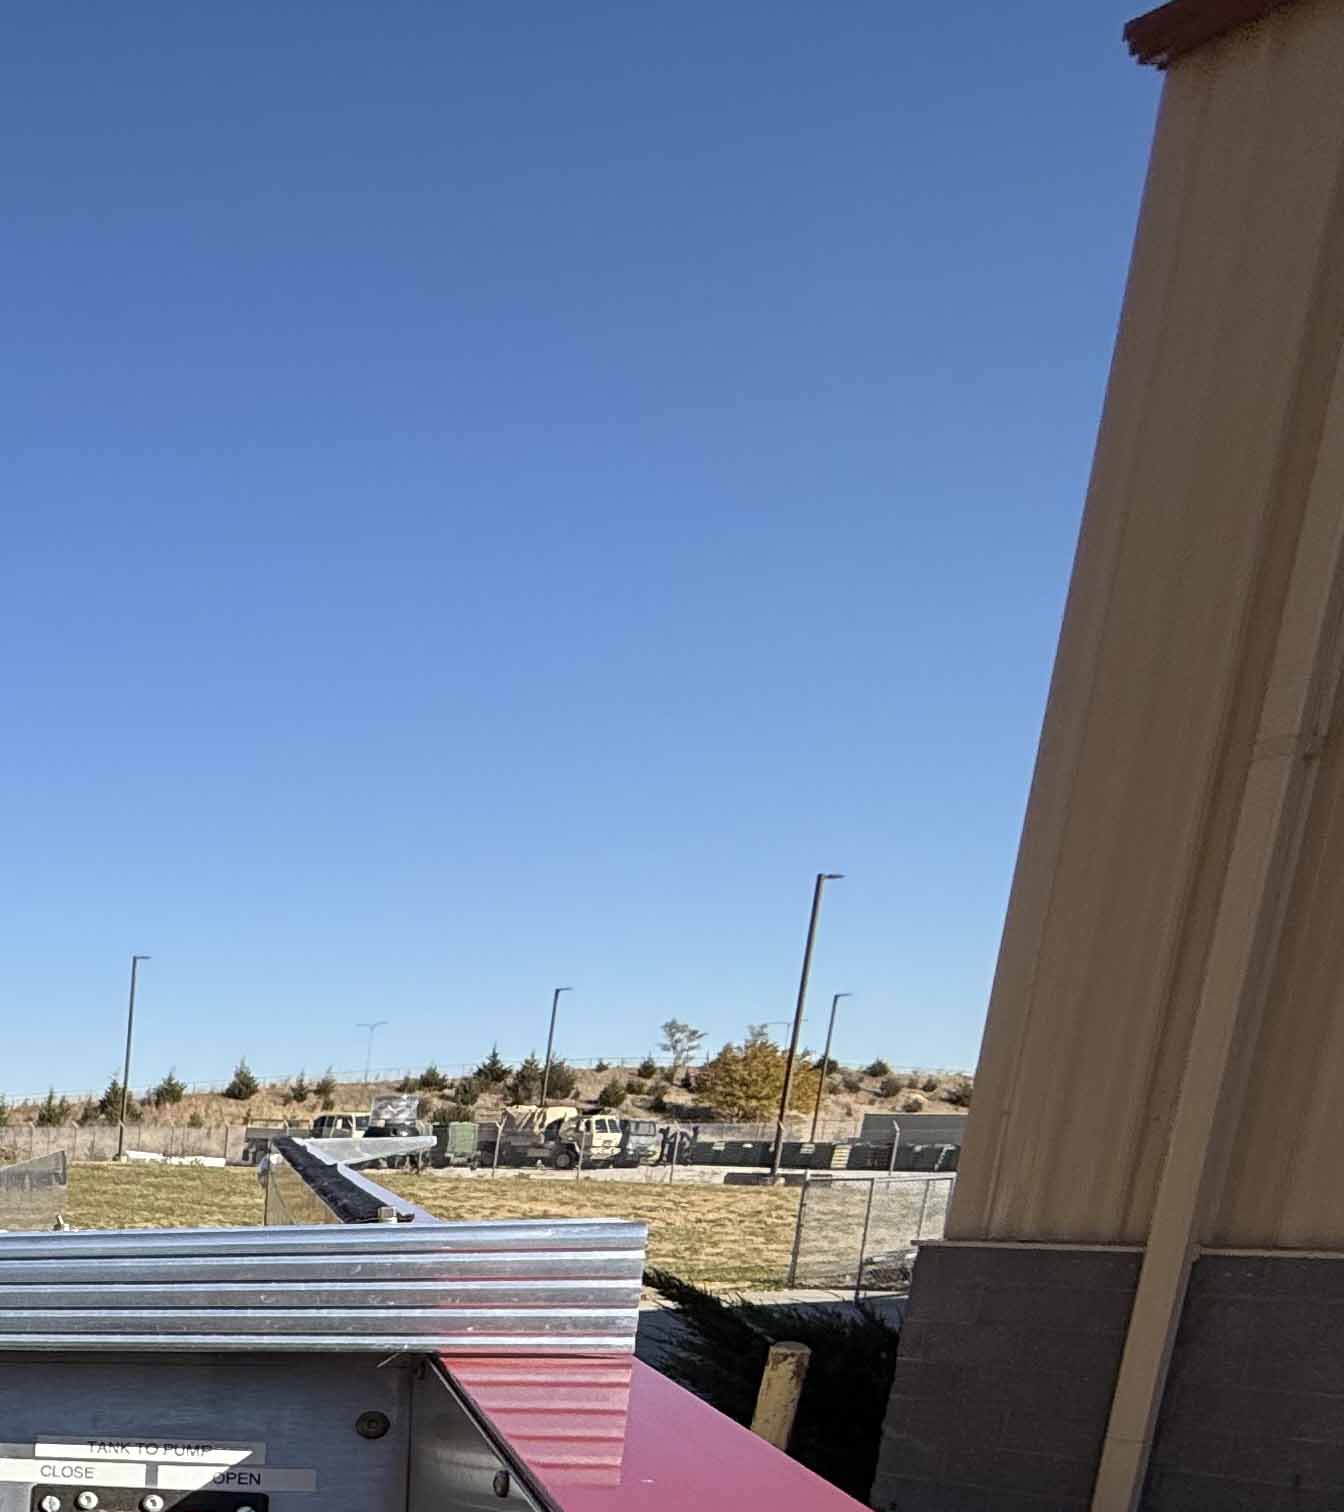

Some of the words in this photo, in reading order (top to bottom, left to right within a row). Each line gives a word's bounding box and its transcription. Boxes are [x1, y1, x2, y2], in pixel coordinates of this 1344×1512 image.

[88, 1441, 130, 1455] TANK
[135, 1443, 158, 1456] TO
[164, 1445, 213, 1457] PUMP
[41, 1465, 95, 1480] CLOSE
[213, 1472, 261, 1487] OPEN
